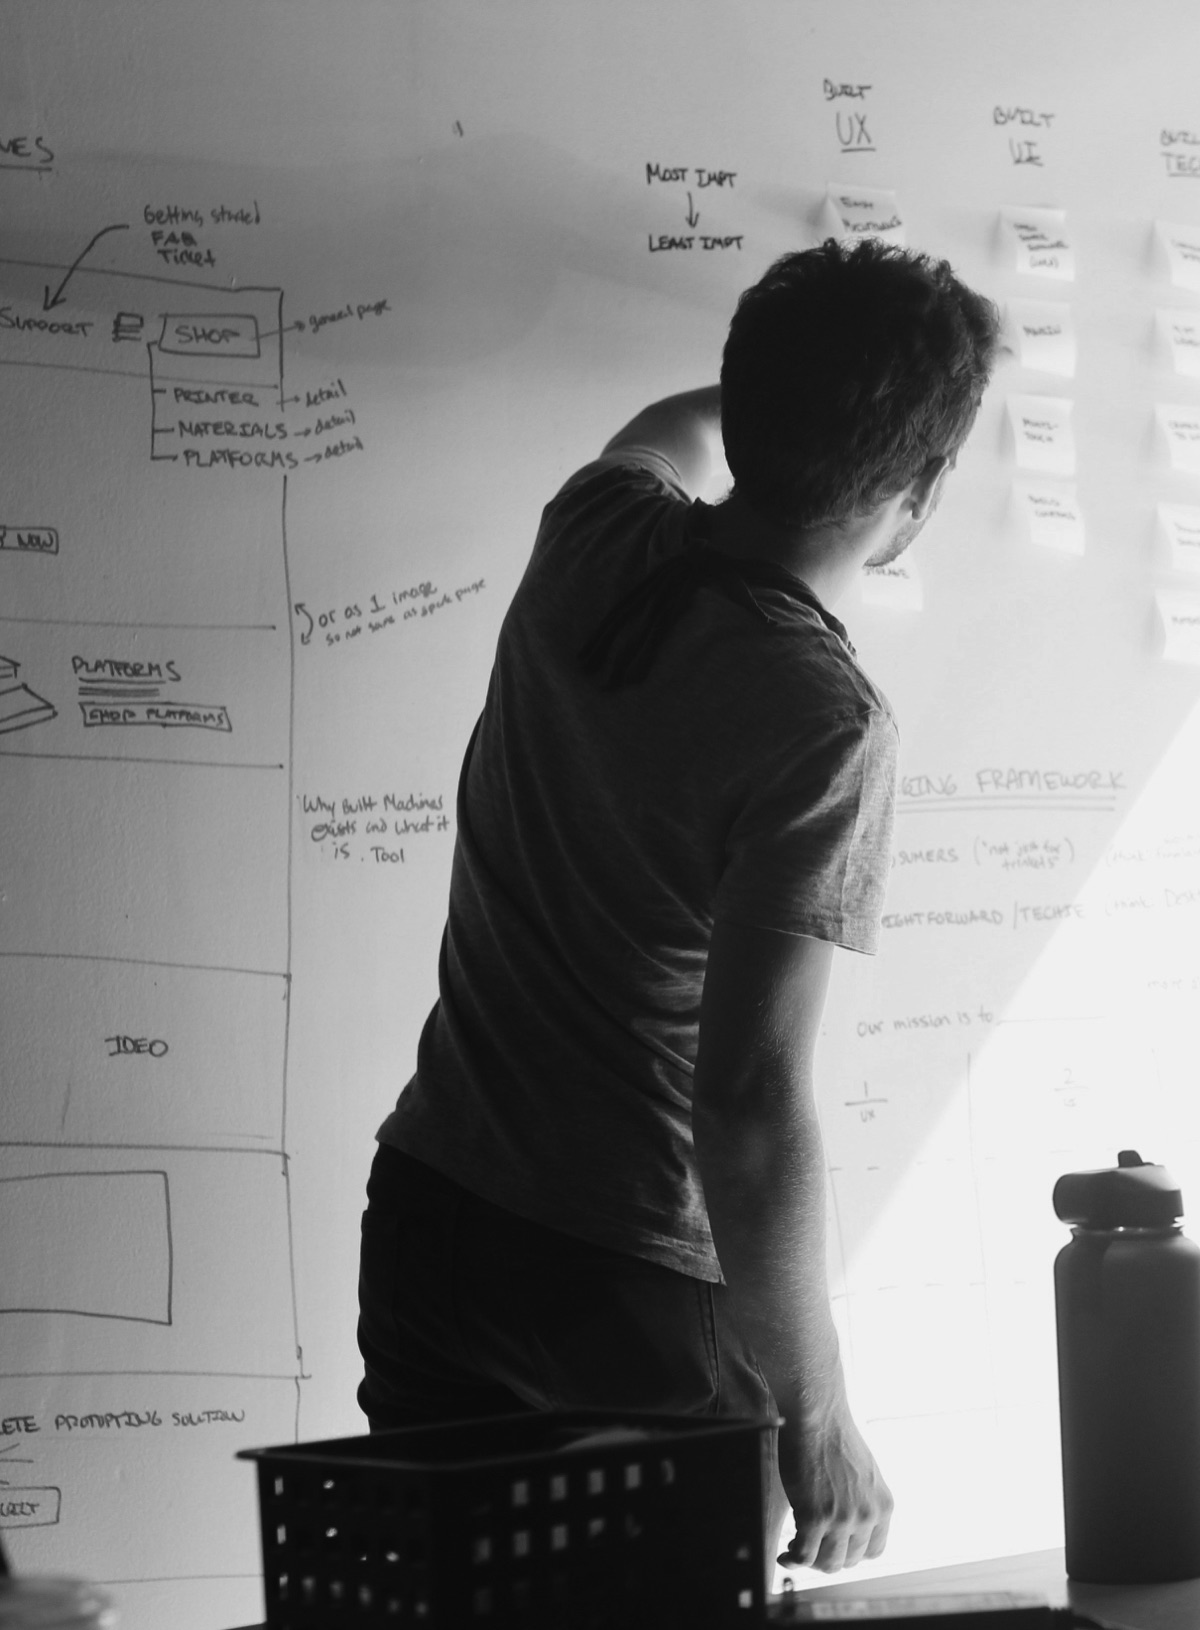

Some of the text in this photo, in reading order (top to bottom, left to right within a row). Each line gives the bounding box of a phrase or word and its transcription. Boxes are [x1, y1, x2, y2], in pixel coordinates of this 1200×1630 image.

[993, 105, 1055, 128] BUILT
[836, 112, 872, 146] UX
[646, 163, 688, 186] MOST
[144, 204, 203, 229] Getting
[648, 234, 695, 253] LEAST
[157, 249, 216, 268] Ticket
[174, 326, 242, 344] SHOP
[173, 388, 260, 407] PRINTER
[178, 421, 289, 440] MATERIALS
[183, 449, 299, 468] PLATFORMS
[15, 532, 54, 550] NOW
[319, 610, 337, 627] or
[344, 604, 362, 620] as
[392, 581, 437, 605] image
[403, 607, 418, 620] as
[72, 655, 181, 681] PLATFORMS
[89, 708, 224, 727] SHOP PLATFORMS
[976, 768, 1127, 793] FRAMEWORK
[303, 794, 335, 817] Why
[437, 814, 450, 832] it
[370, 846, 405, 864] Tool
[892, 848, 960, 869] SUMERS
[893, 1013, 952, 1031] mission
[957, 1010, 972, 1026] is
[978, 1005, 994, 1024] to
[105, 1036, 169, 1058] IDEO
